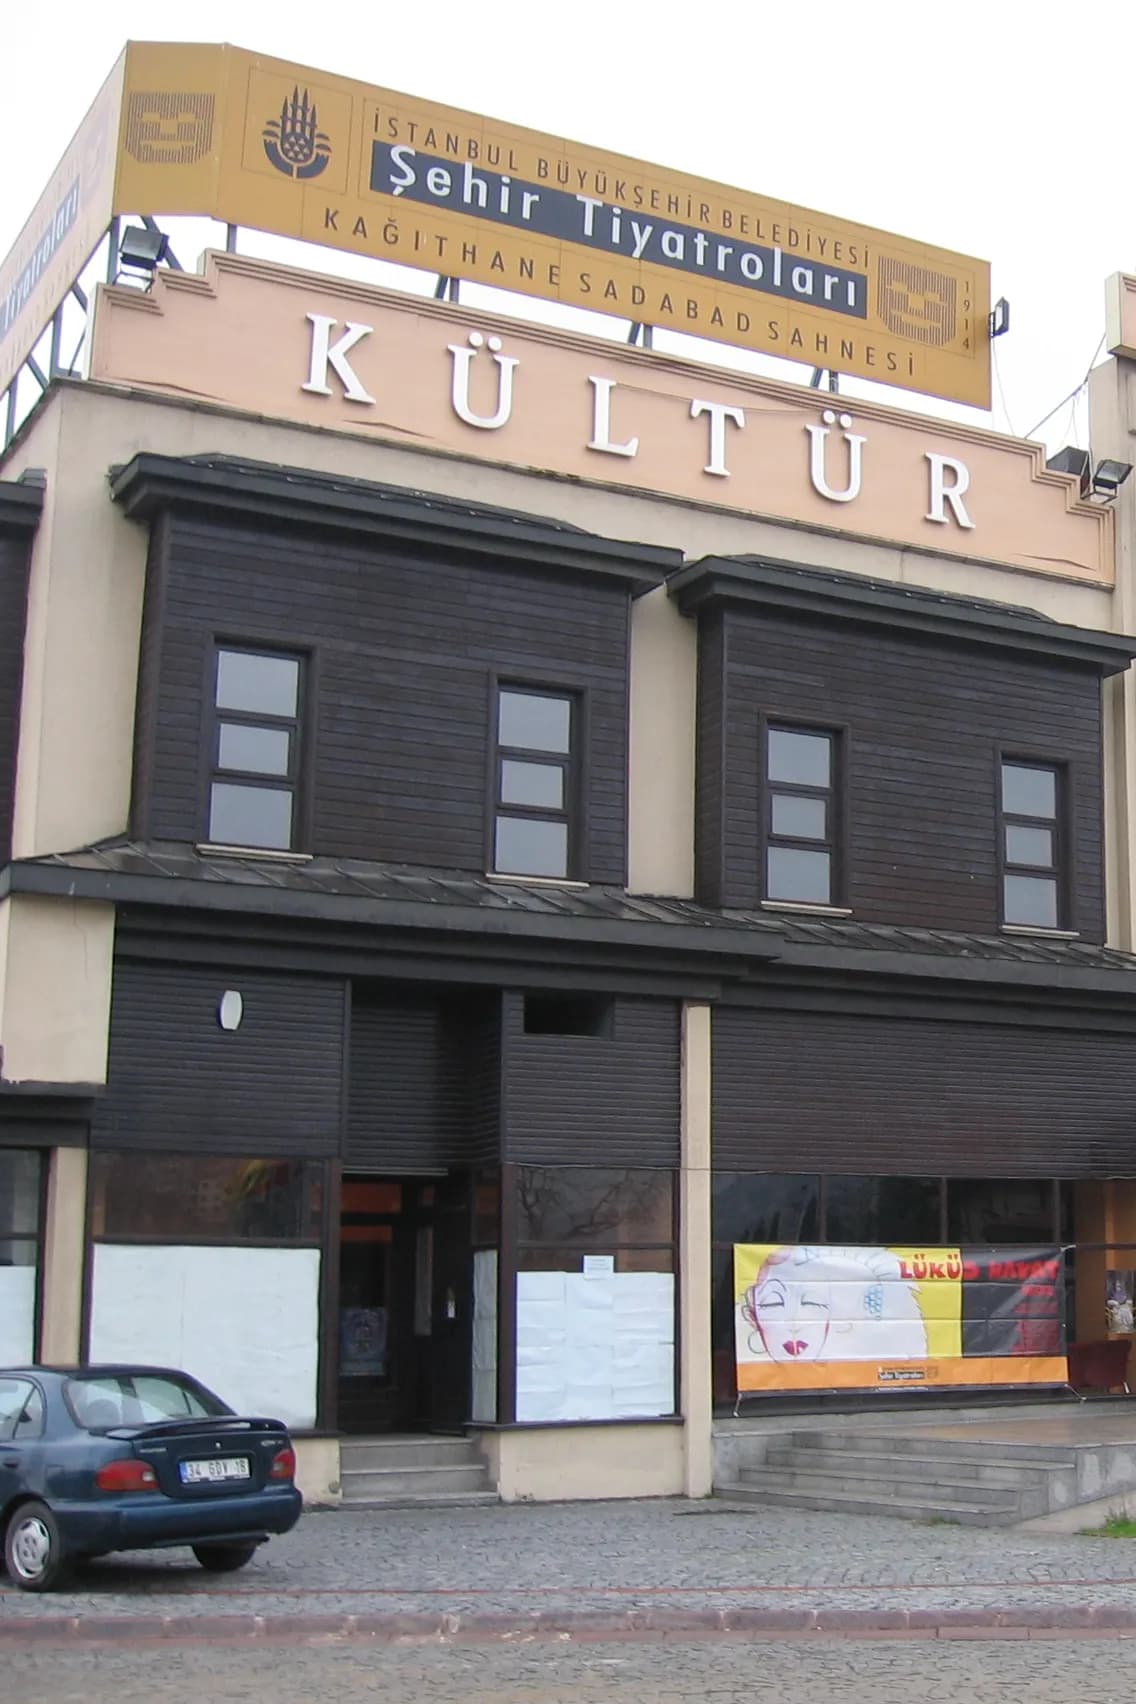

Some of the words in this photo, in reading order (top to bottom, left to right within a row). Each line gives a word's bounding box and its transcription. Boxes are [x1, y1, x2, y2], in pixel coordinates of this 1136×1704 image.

[373, 107, 519, 170] İSTANBUL
[536, 157, 711, 224] BÜYÜKŞEHİR
[721, 209, 870, 269] BELEDİYESİ
[388, 144, 540, 220] Şehir
[575, 193, 856, 307] Tiyatroları
[323, 206, 561, 286] KAĞITHANE
[579, 272, 751, 332] SADABAD
[768, 320, 915, 376] SAHNESİ
[301, 312, 976, 529] KÜLTÜR
